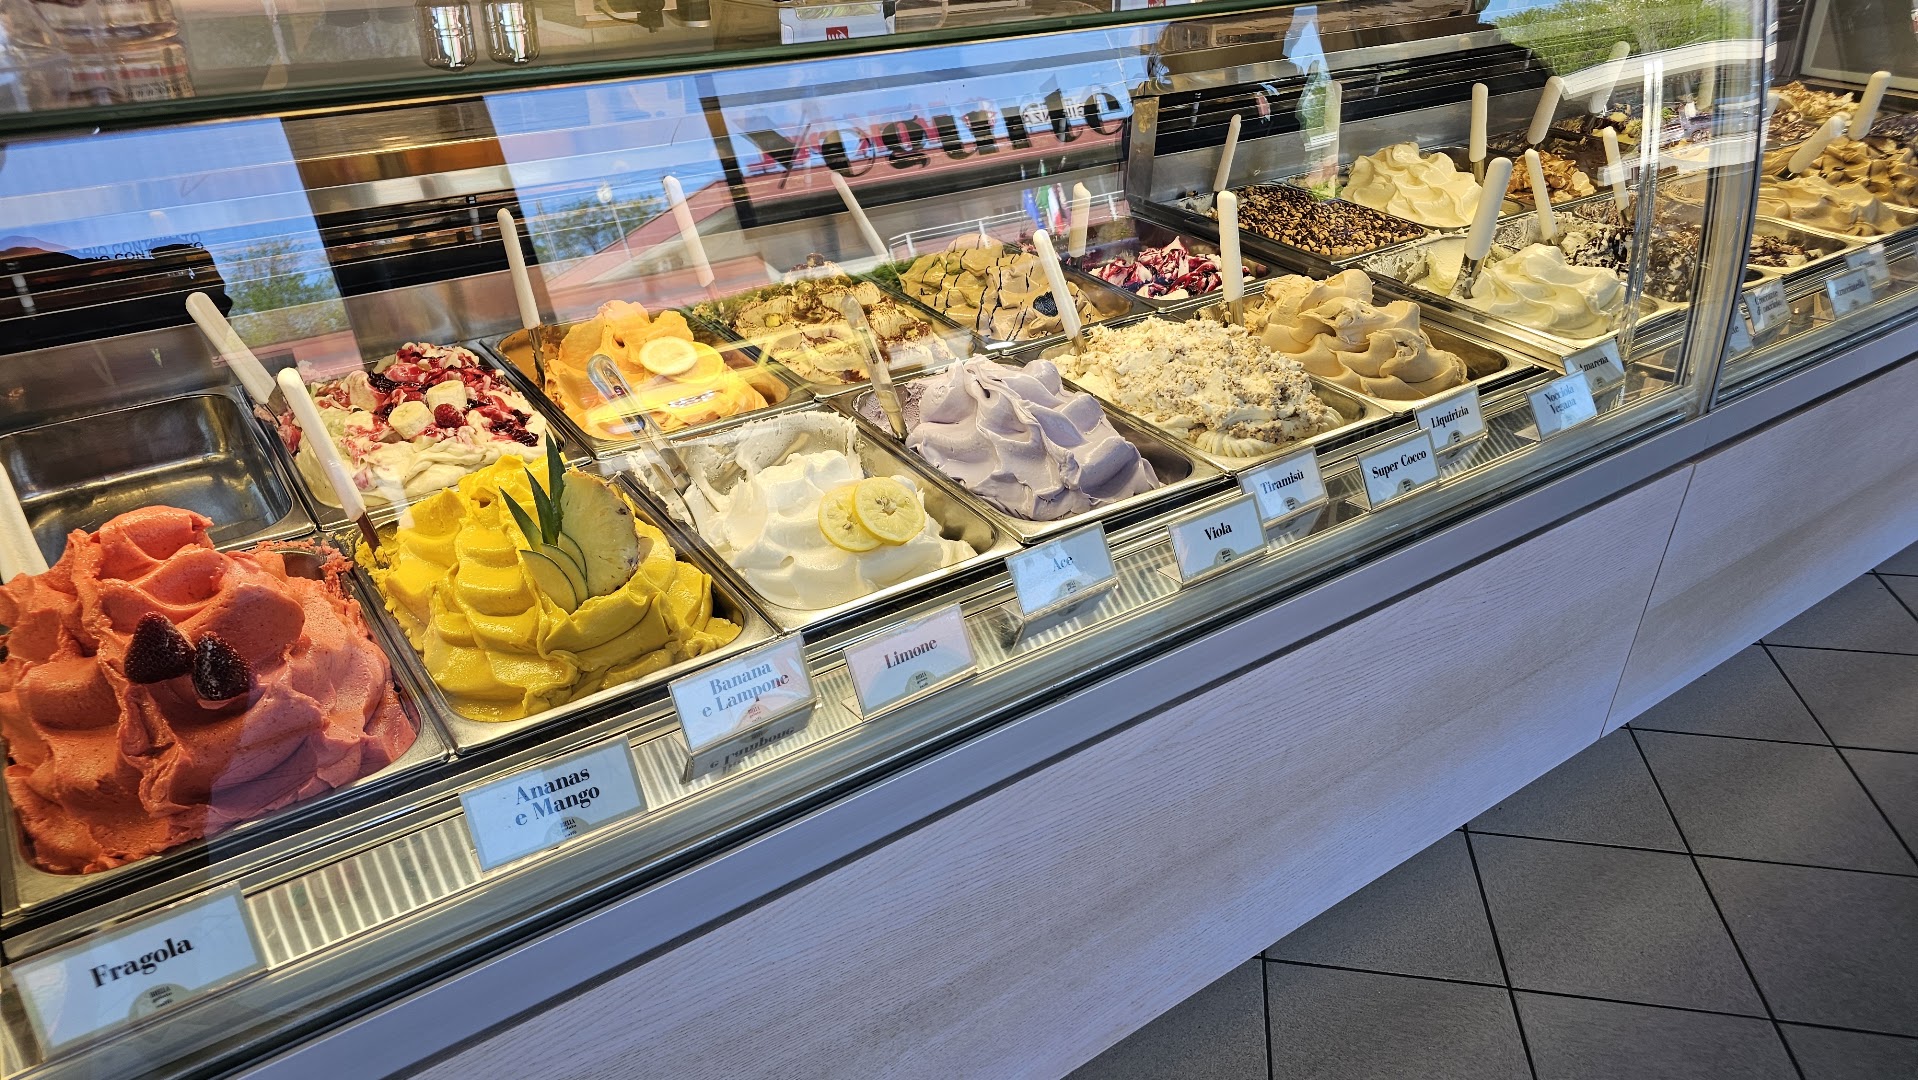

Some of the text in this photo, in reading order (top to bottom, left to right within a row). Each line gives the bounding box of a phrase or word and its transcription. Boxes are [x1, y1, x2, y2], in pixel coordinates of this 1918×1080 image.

[1544, 384, 1575, 405] Nocciola
[1431, 406, 1470, 429] Liquirizia
[1372, 450, 1427, 479] Super Cocco
[1260, 469, 1305, 495] Tiramisù
[1204, 522, 1233, 541] Viola
[1053, 556, 1074, 572] Ace
[884, 639, 938, 669] Limone
[709, 663, 772, 695] Banana
[702, 674, 790, 718] e Lampone
[515, 768, 590, 806] Ananas
[515, 786, 600, 826] e Mango
[88, 937, 195, 988] Fragola
